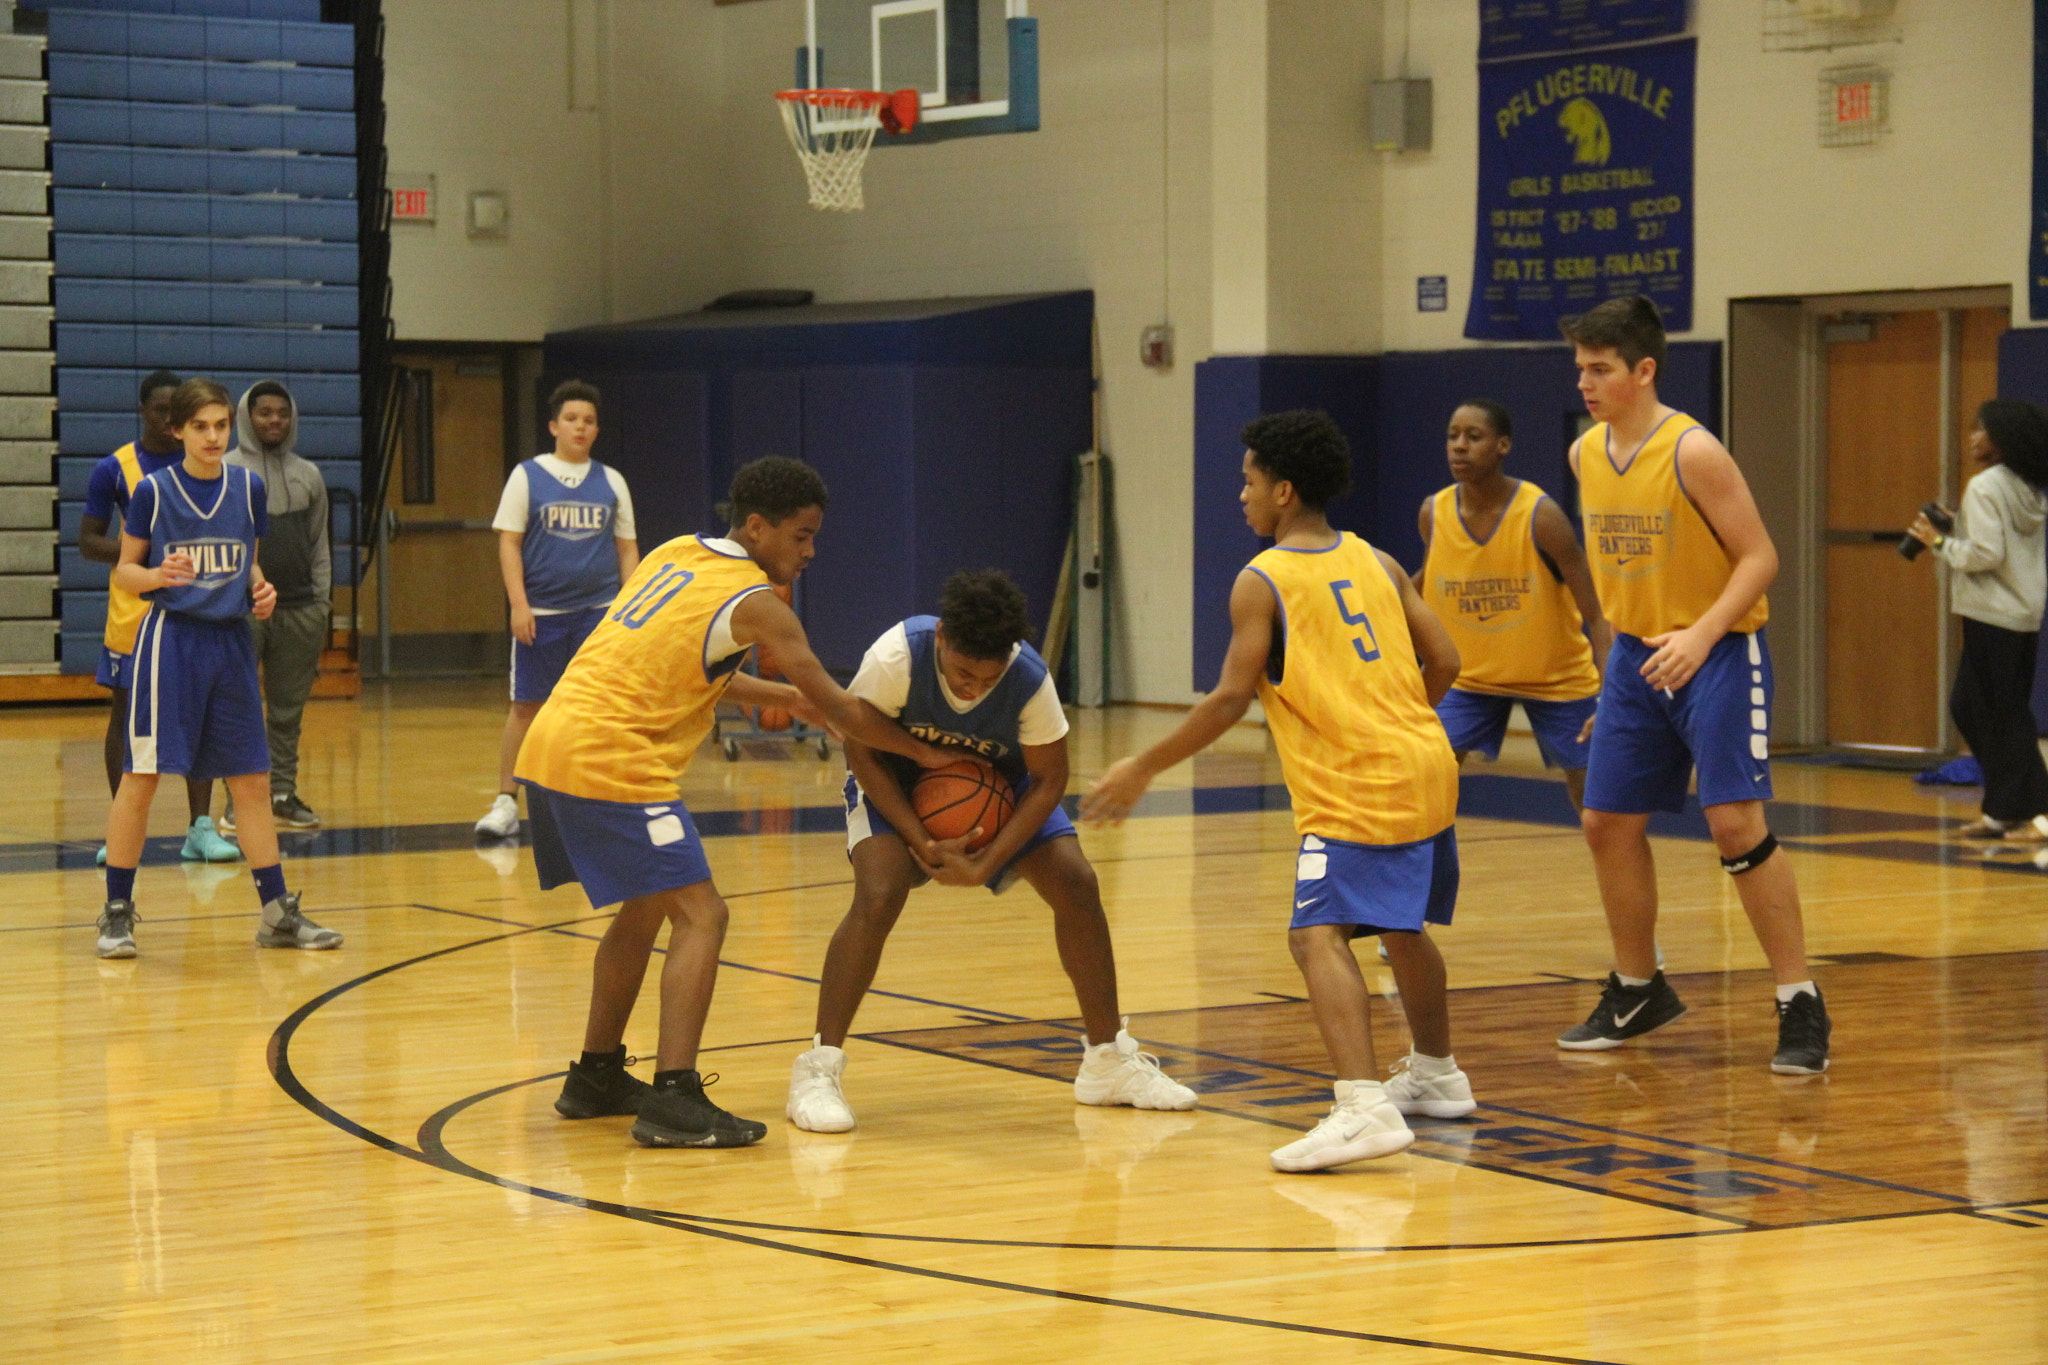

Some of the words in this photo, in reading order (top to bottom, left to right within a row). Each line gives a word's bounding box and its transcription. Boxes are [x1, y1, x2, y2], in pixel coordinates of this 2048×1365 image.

[1496, 64, 1673, 139] PFLUGERVILLE
[1837, 85, 1871, 121] EXIT
[395, 189, 427, 216] EXIT
[547, 506, 603, 529] PVILLE
[1598, 535, 1653, 556] PANTHERS
[611, 563, 695, 630] 10
[1458, 594, 1521, 613] PANTHERS
[1328, 579, 1382, 663] 5
